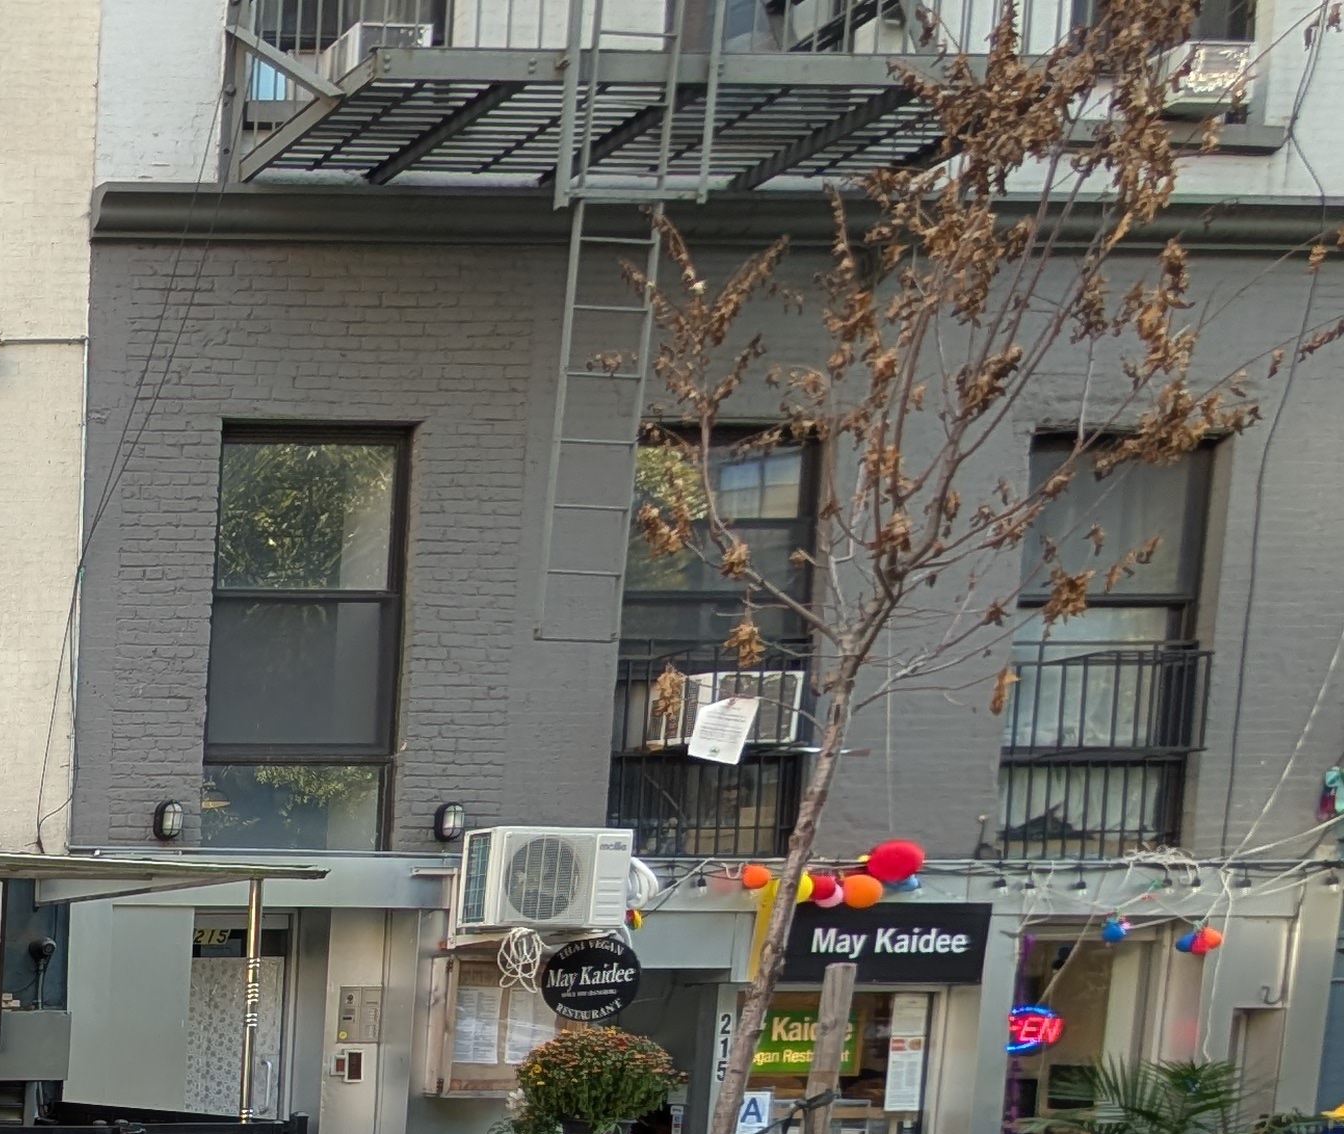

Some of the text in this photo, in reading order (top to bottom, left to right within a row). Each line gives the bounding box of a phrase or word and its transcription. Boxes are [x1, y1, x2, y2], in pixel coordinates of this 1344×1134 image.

[193, 928, 229, 944] 215
[588, 939, 625, 956] VEGAN
[811, 926, 971, 960] May Kaidee
[545, 961, 635, 993] May Kaidee
[740, 1097, 763, 1123] A
